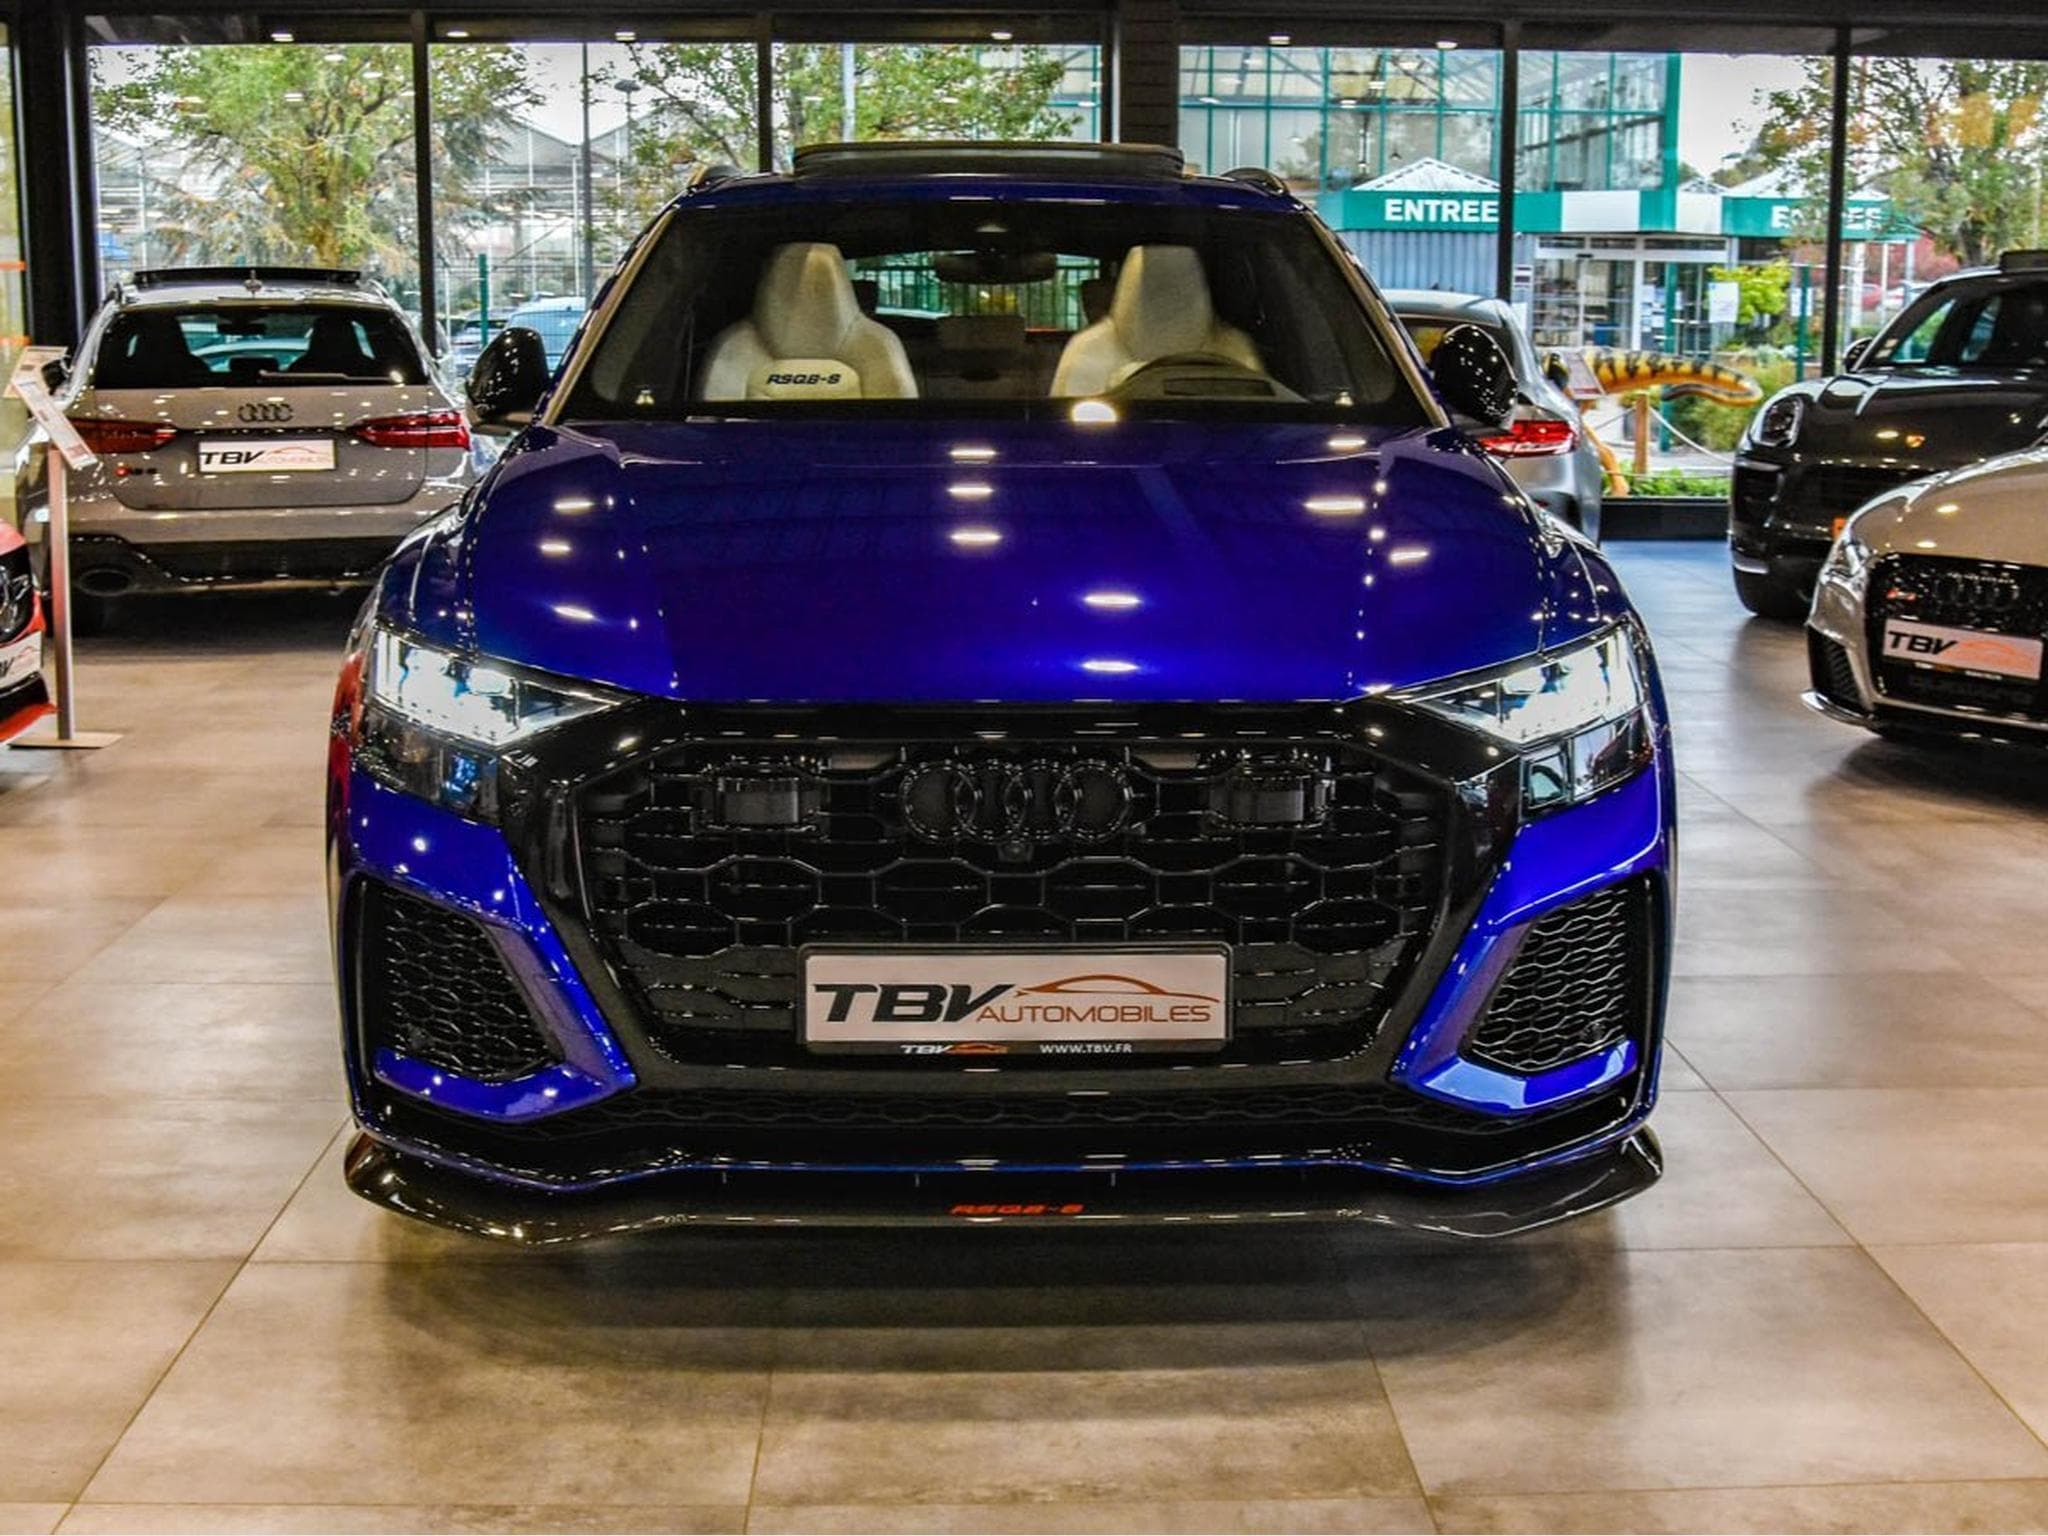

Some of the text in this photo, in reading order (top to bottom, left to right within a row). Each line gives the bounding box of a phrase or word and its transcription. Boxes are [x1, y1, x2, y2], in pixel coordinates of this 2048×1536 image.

[201, 450, 264, 465] TBV
[1888, 630, 1958, 655] TBV
[813, 983, 1211, 1023] TBV AUTOMOBILES
[901, 1043, 1132, 1055] TBV WWW.TBV.FR
